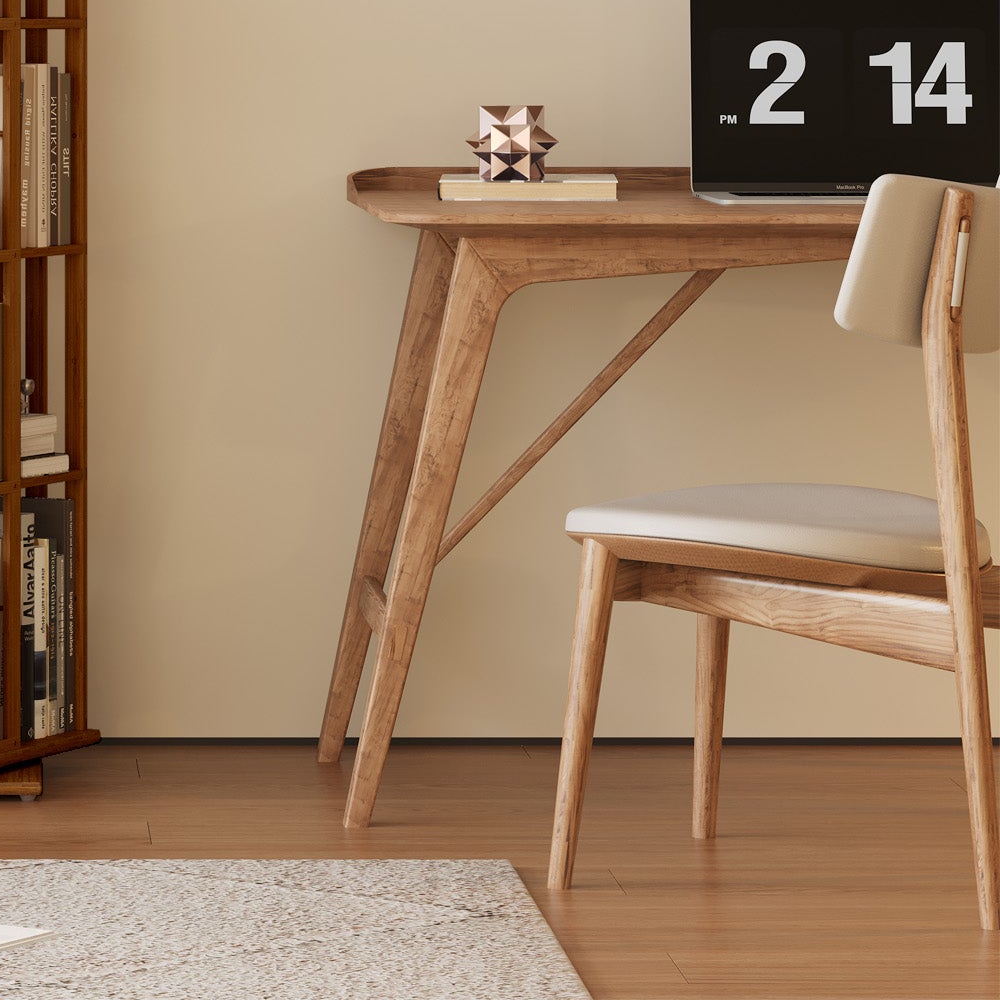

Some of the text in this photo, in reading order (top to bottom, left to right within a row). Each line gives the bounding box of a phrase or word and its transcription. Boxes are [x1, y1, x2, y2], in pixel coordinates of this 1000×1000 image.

[720, 40, 973, 125] PM 2 14
[23, 523, 36, 571] Aalto
[23, 572, 35, 618] Alvar
